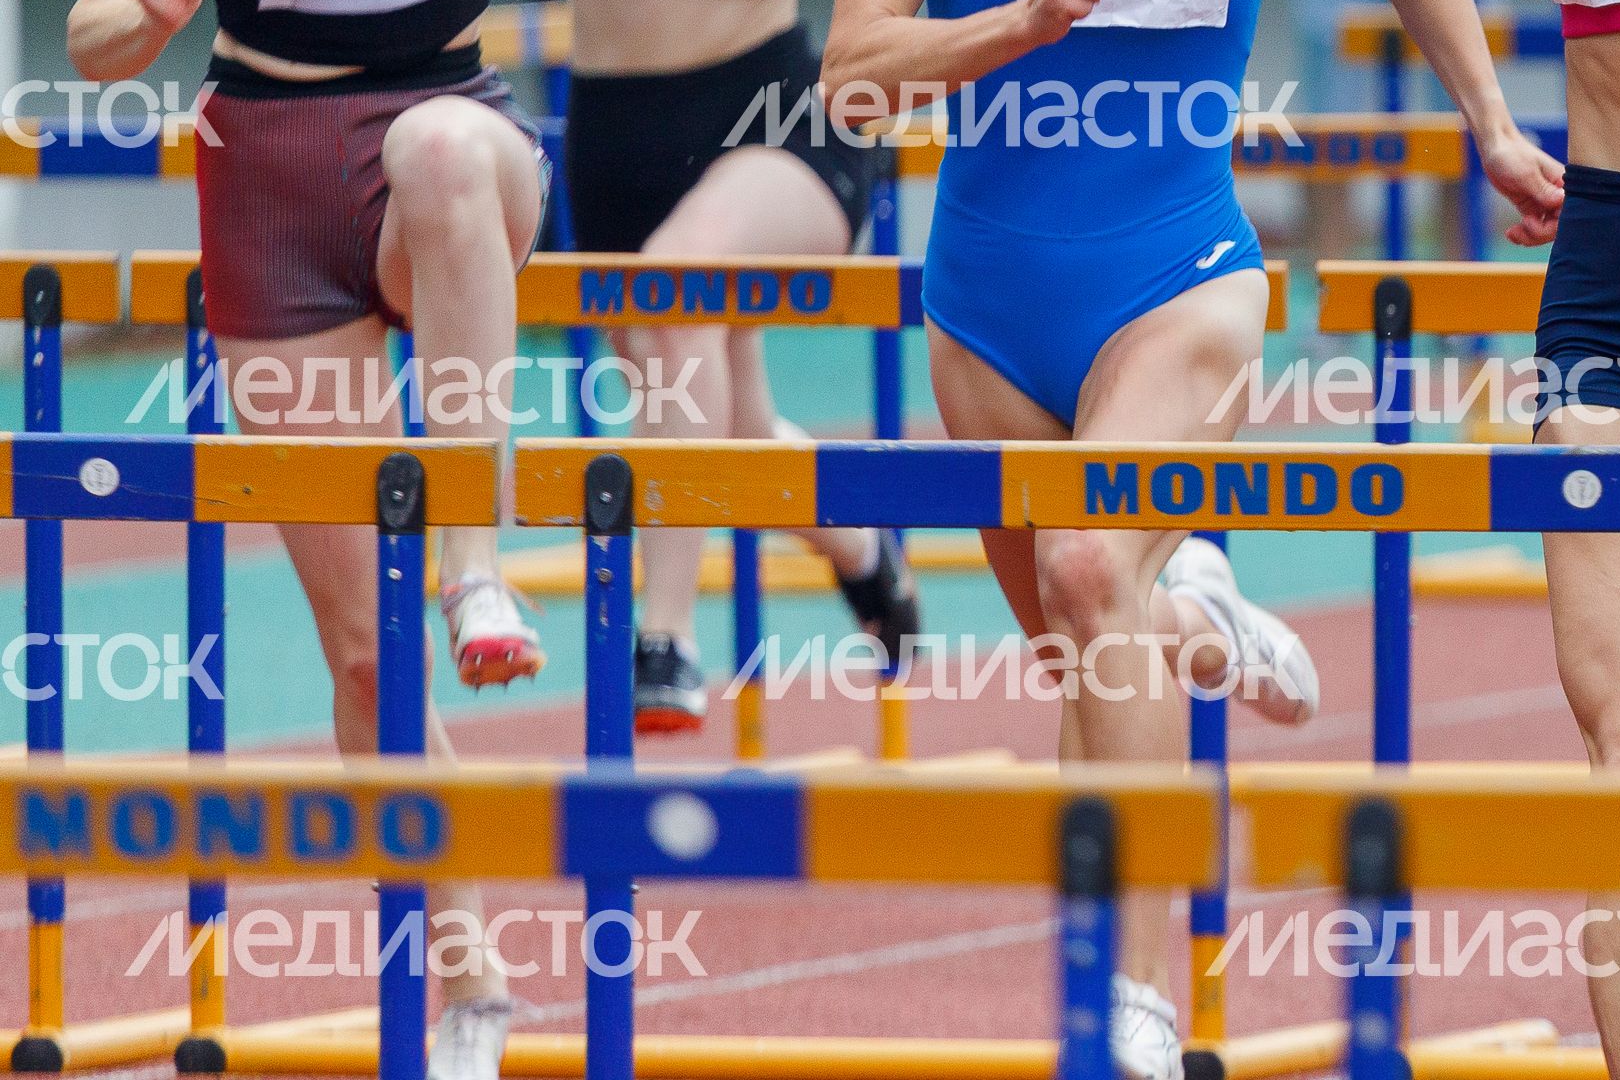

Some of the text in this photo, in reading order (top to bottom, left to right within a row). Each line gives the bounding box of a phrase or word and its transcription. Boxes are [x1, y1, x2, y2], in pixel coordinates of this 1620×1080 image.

[580, 270, 833, 315] MONDO
[1084, 462, 1404, 516] MONDO
[20, 786, 452, 862] MONDO
